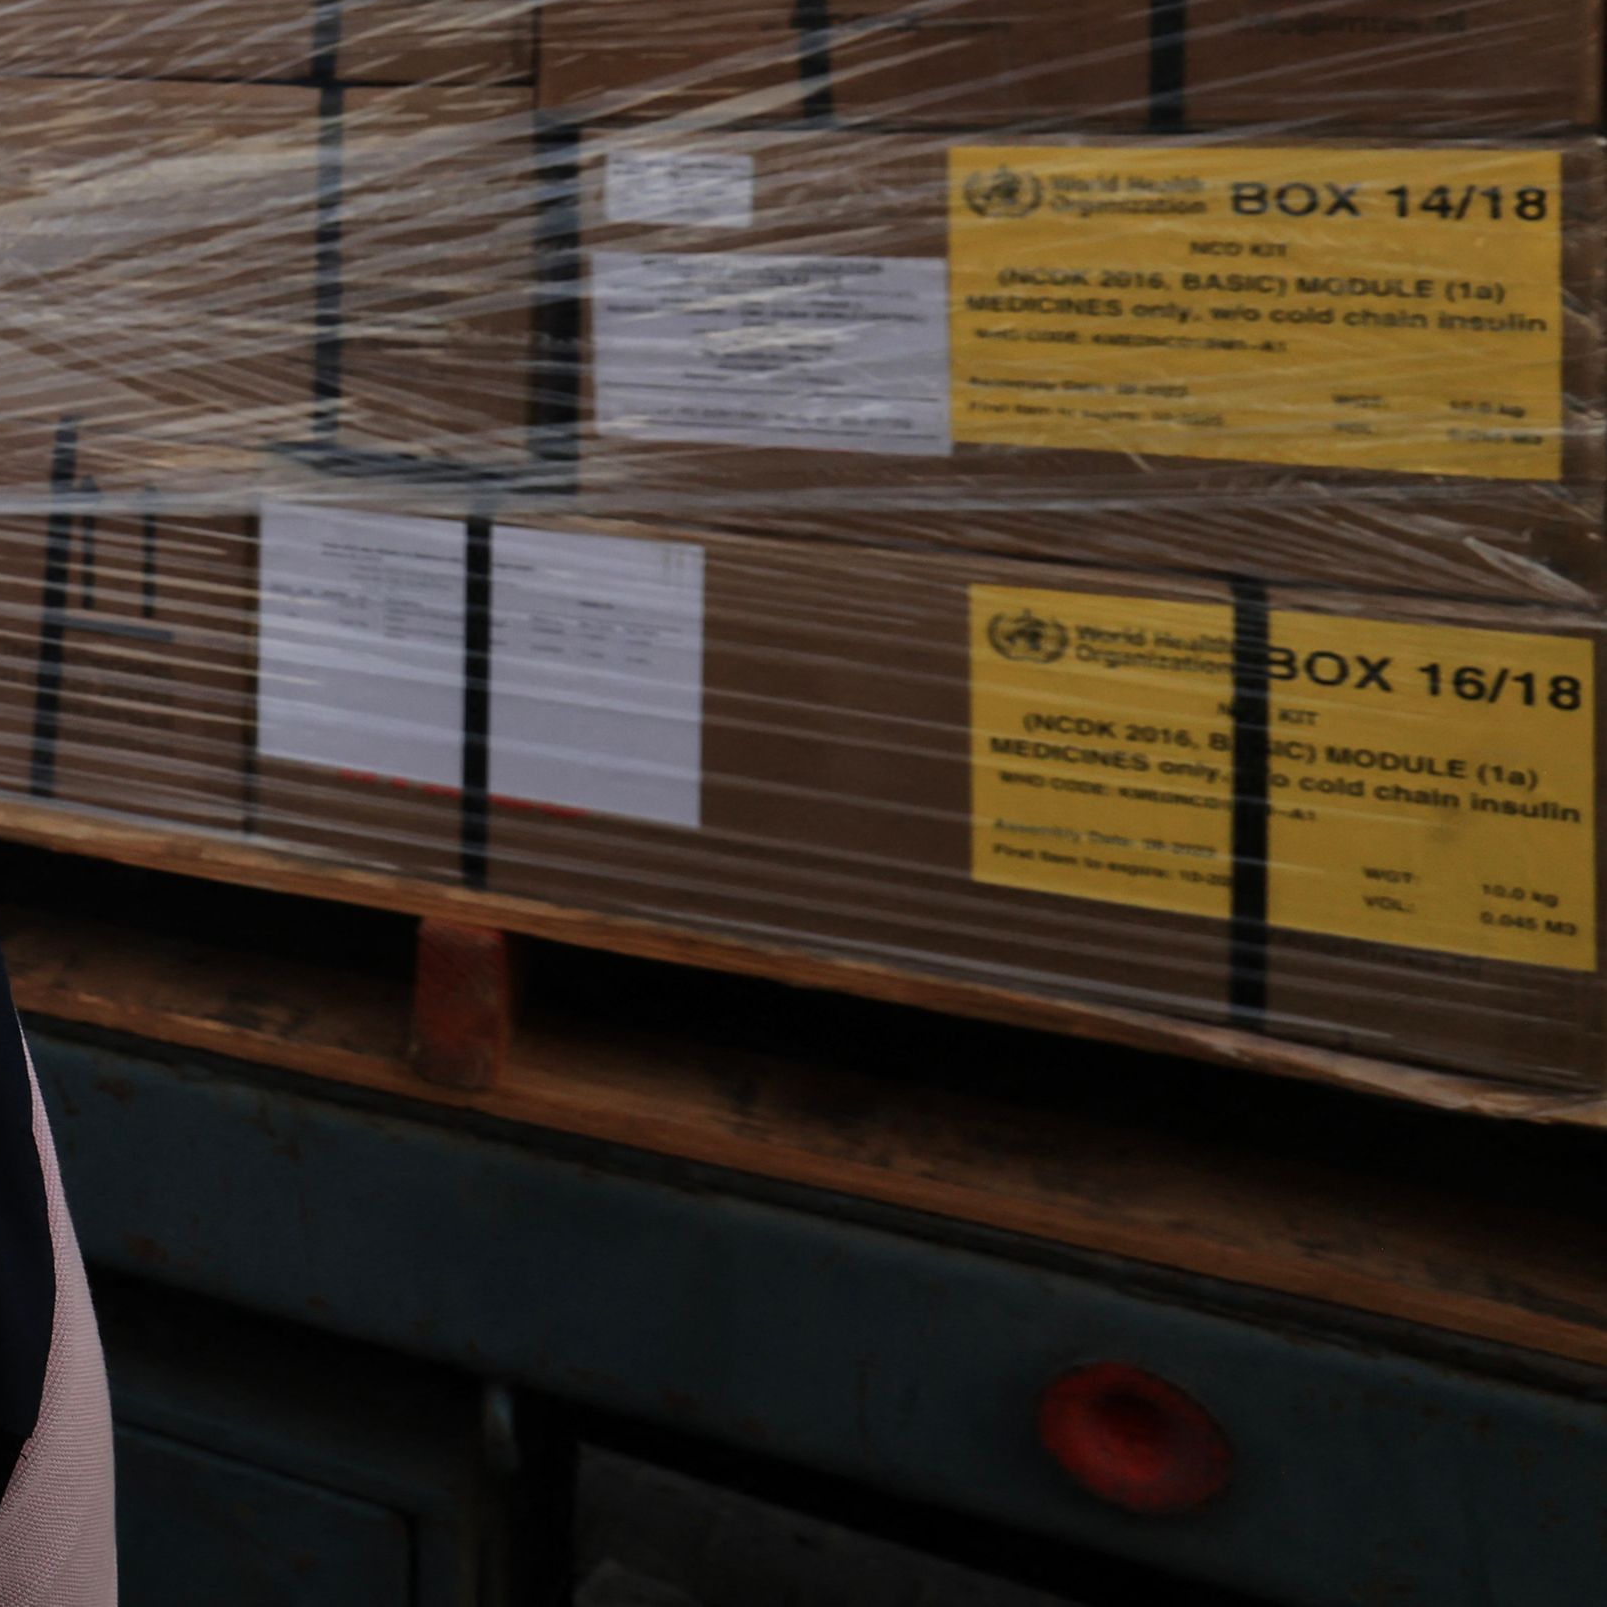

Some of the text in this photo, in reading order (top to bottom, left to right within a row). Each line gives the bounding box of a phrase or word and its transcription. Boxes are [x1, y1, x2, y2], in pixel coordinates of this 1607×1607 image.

[1231, 182, 1548, 222] BOX 14/18
[965, 294, 1124, 317] MEDICINES
[1268, 304, 1335, 326] cold
[1341, 308, 1429, 330] chain
[1436, 309, 1549, 334] insulin
[1181, 270, 1287, 297] BASIC)
[1296, 274, 1436, 299] MODULE
[1444, 279, 1507, 305] (1a)
[1265, 645, 1583, 712] BOX 16/18
[1022, 711, 1539, 792] (NCDK 2016, MODULE (1a)
[989, 735, 1150, 773] MEDICINES
[1298, 772, 1366, 799] cold
[1373, 782, 1460, 811] chain
[1469, 791, 1582, 824] insulin
